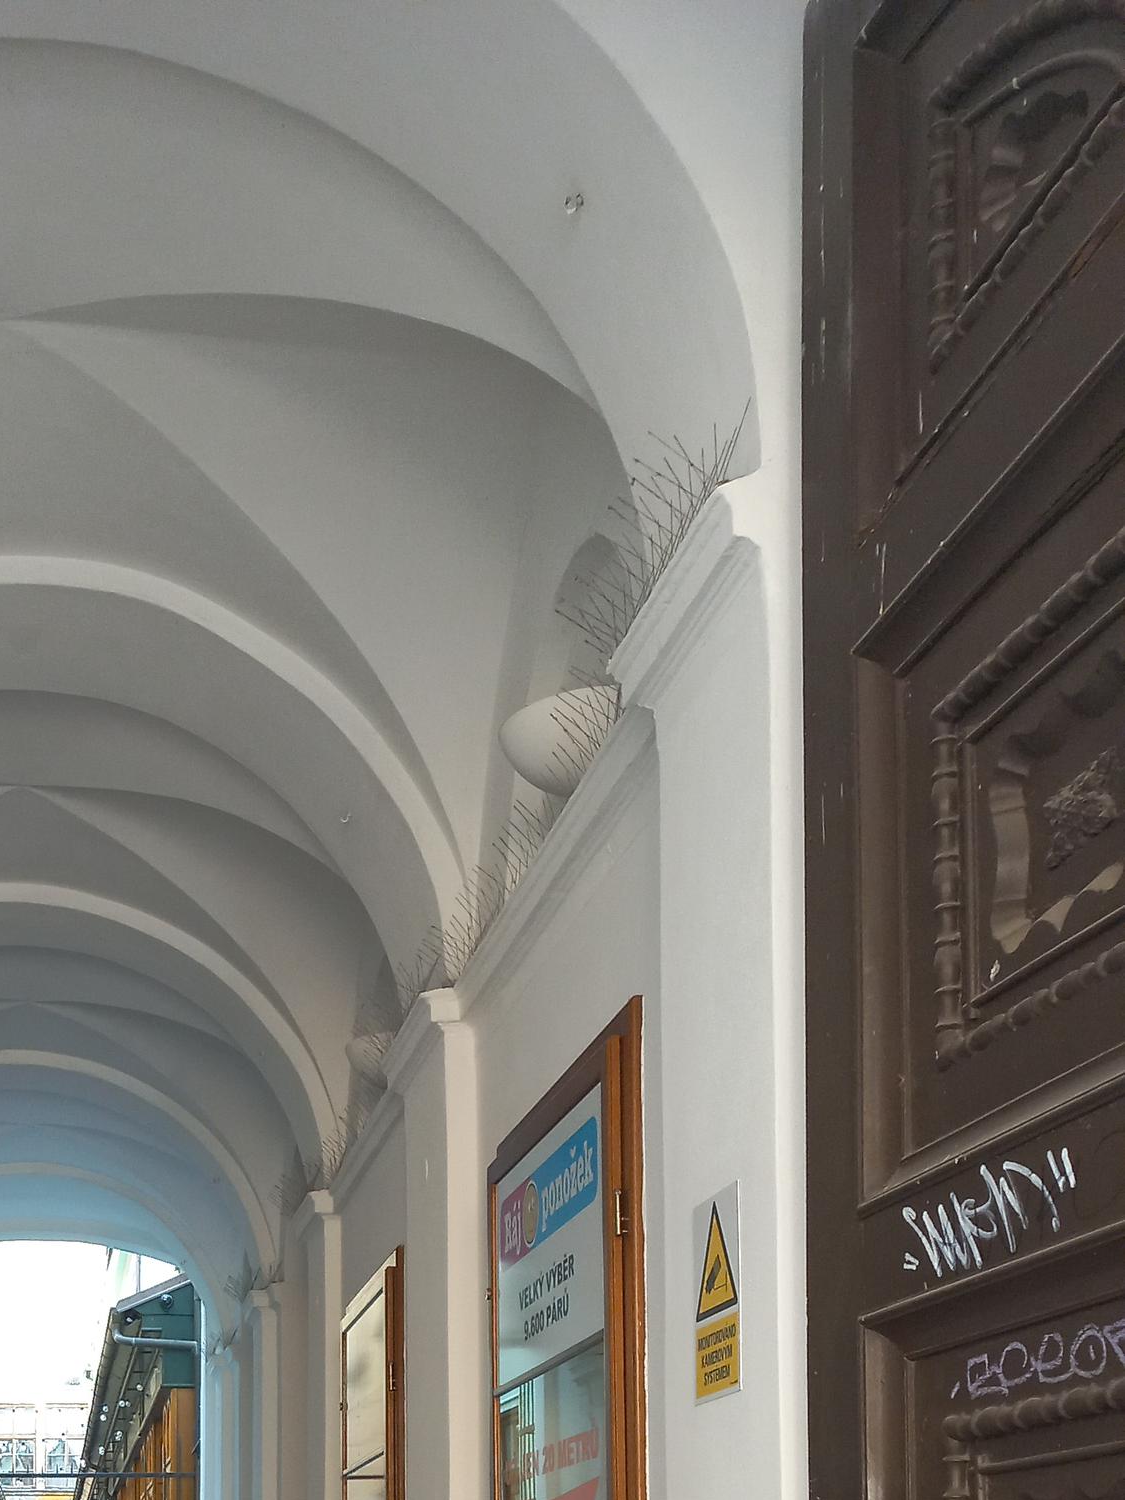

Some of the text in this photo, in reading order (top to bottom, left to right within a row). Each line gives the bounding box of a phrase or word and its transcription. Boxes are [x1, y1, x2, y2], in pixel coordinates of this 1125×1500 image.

[504, 1140, 594, 1256] Ráj ponožek
[519, 1253, 574, 1311] VELKÝ VÝBĚR
[524, 1287, 569, 1341] 9.600 PÁRŮ
